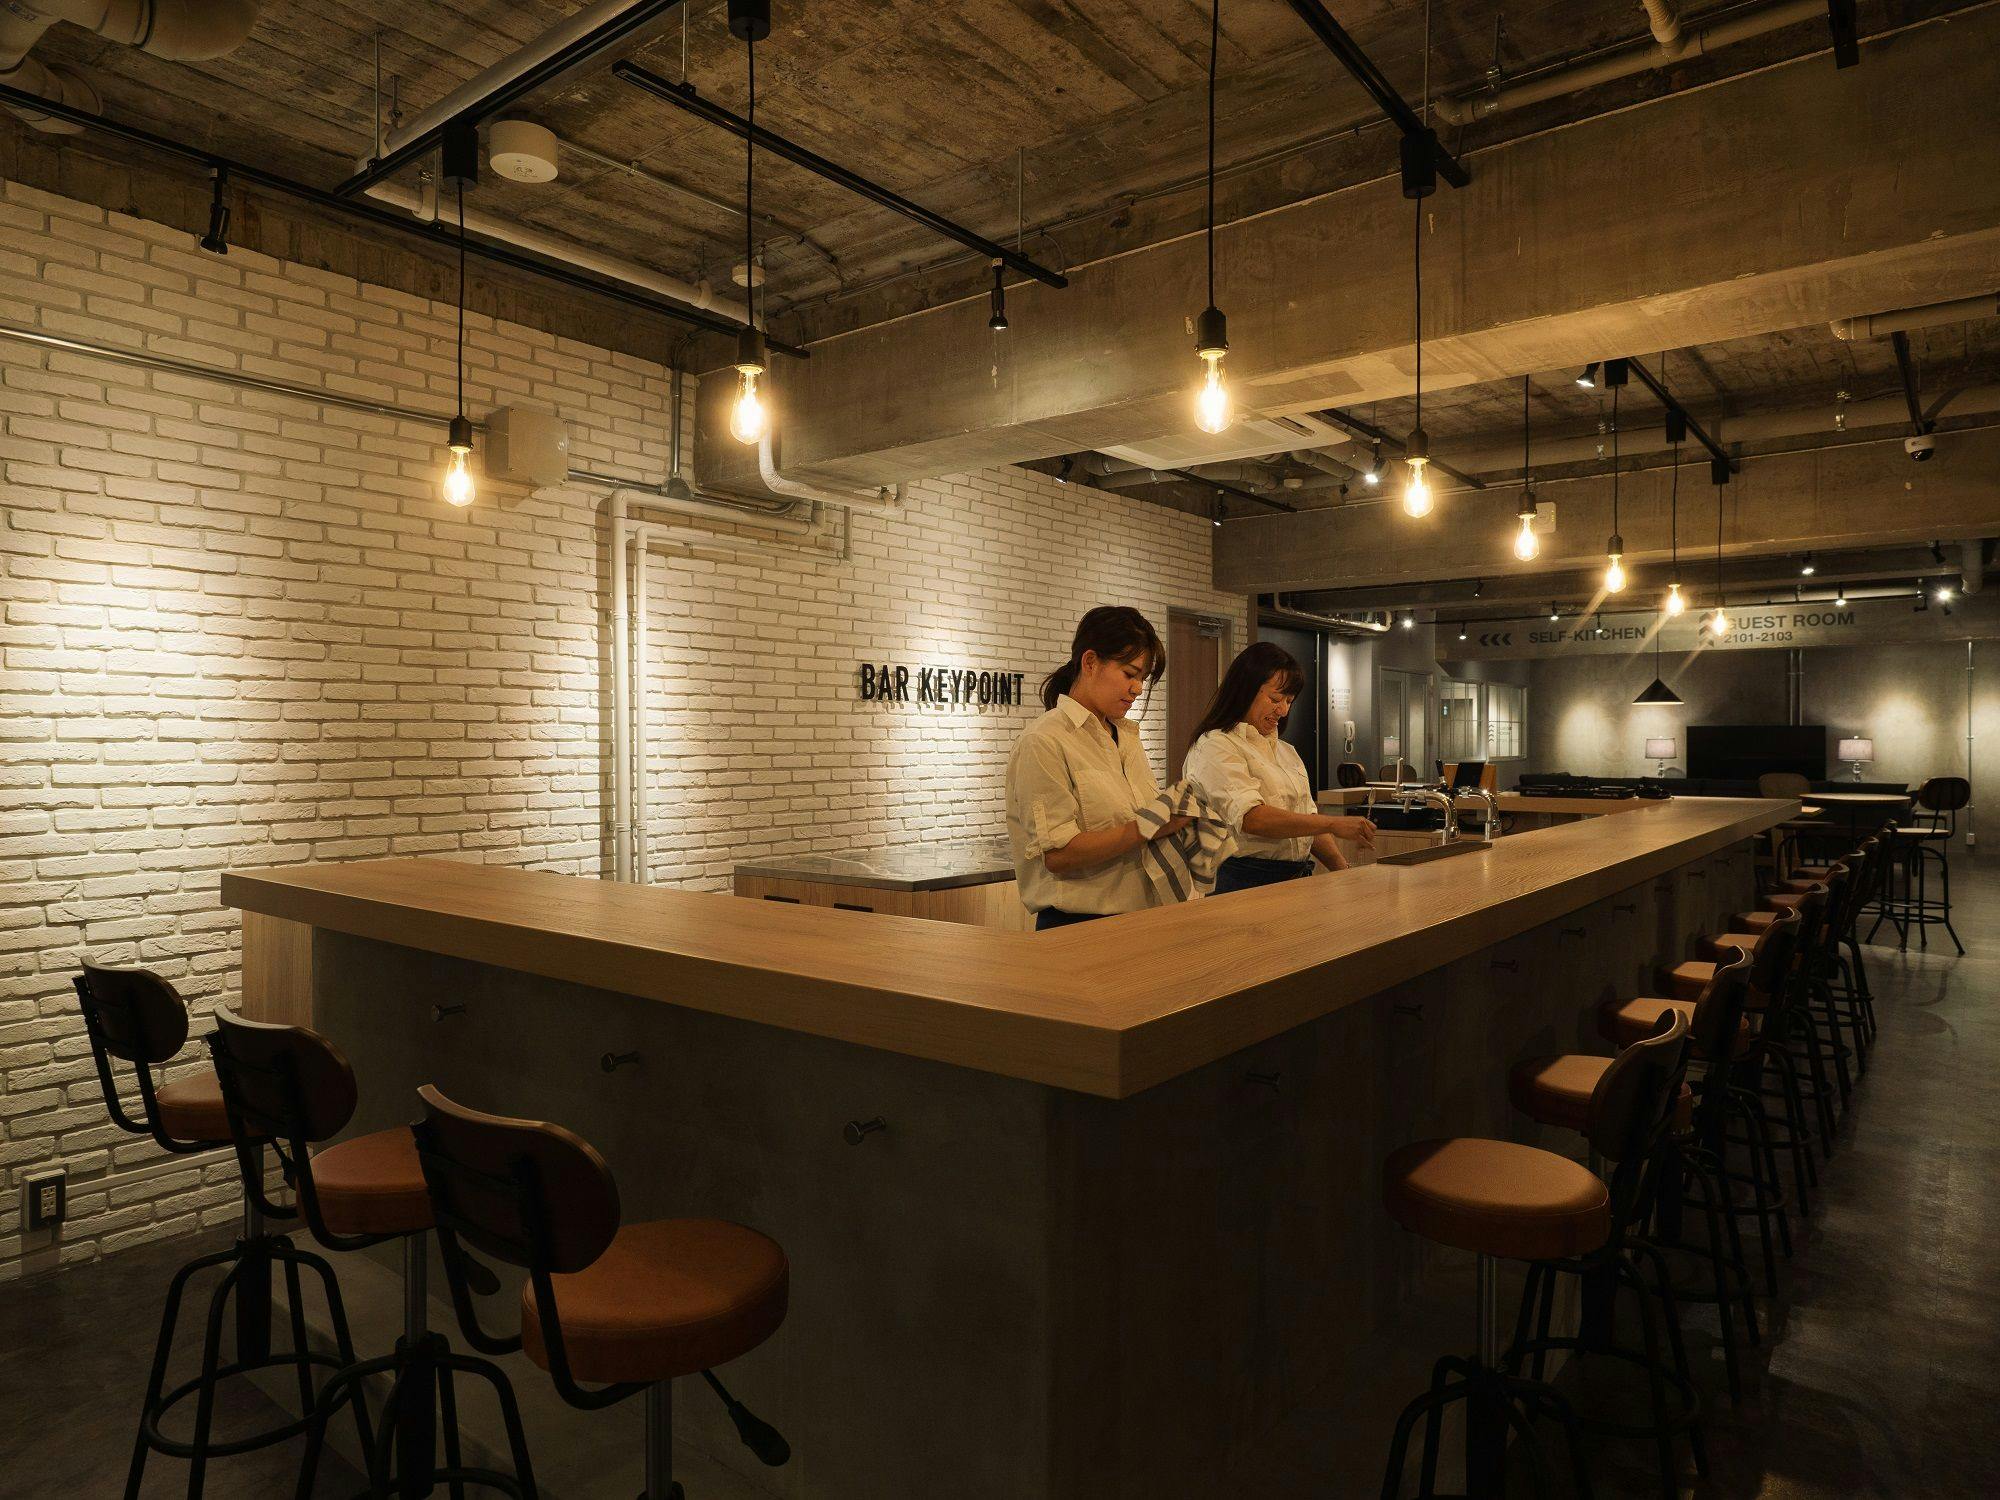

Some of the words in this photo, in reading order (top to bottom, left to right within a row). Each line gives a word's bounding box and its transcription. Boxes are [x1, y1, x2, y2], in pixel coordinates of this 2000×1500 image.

[1726, 615, 1787, 630] GUEST
[1793, 612, 1855, 627] ROOM
[1529, 627, 1646, 643] SELF-KITCHEN
[1724, 631, 1793, 644] 2101-2103
[861, 663, 909, 702] BAR
[921, 667, 1025, 706] KEYPOINT
